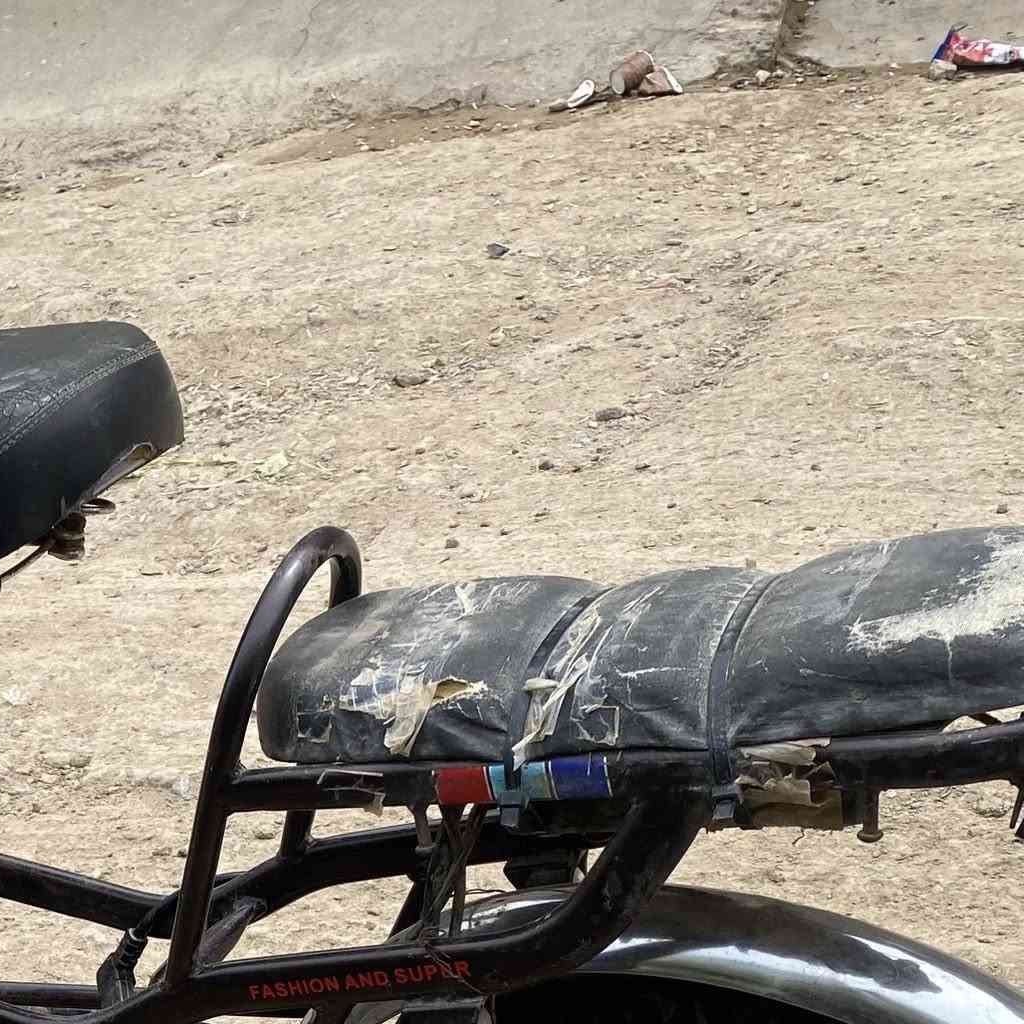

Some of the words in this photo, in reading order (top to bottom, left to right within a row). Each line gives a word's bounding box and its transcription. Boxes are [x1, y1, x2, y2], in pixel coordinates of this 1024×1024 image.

[249, 976, 339, 1001] FASHION
[345, 970, 389, 989] AND
[394, 960, 472, 984] SUPER
